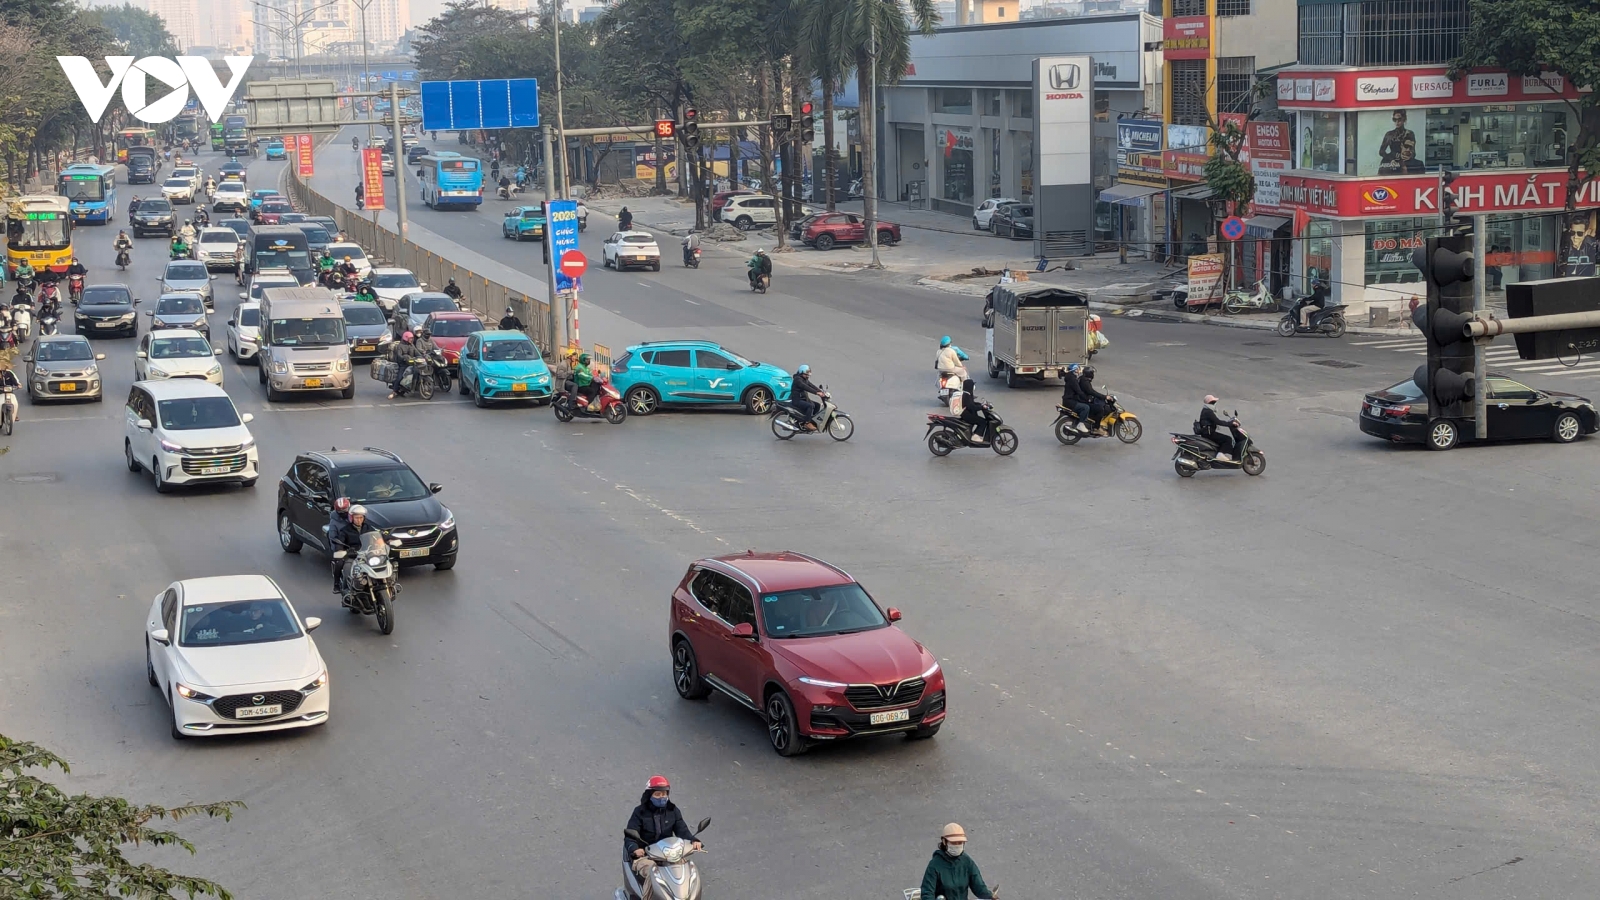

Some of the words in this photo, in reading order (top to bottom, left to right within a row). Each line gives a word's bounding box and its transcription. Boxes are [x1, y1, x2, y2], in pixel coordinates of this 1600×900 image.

[1414, 82, 1452, 91] VERSACE
[1471, 79, 1505, 87] FURLA
[1359, 83, 1396, 97] Chopard
[658, 123, 672, 135] 96
[1256, 125, 1280, 137] ENEOS
[1131, 131, 1160, 142] MICHELIN
[1414, 186, 1485, 210] KNH
[1494, 174, 1561, 207] MẮT
[555, 227, 574, 236] CHÚC
[1373, 237, 1397, 250] ĐO
[1400, 231, 1426, 249] MẮ
